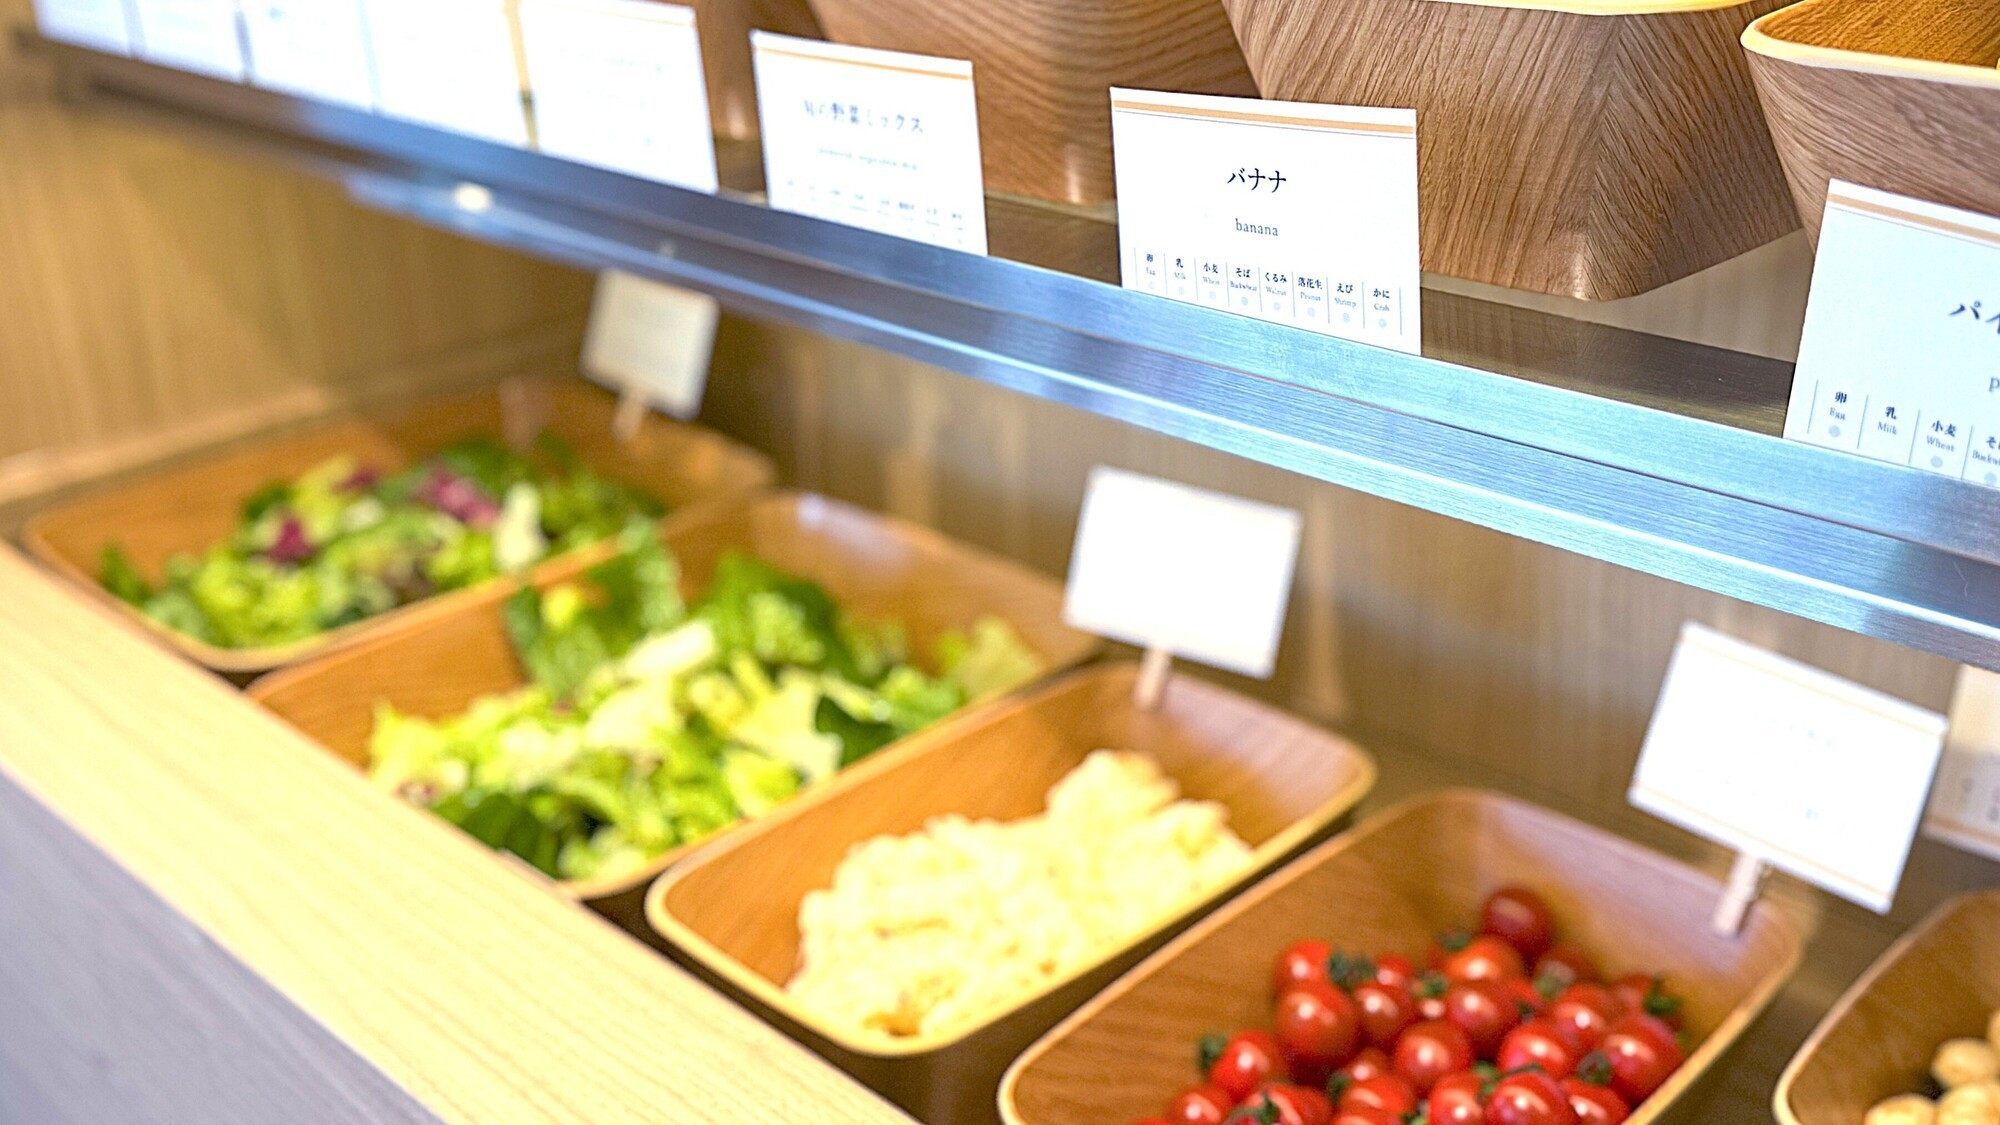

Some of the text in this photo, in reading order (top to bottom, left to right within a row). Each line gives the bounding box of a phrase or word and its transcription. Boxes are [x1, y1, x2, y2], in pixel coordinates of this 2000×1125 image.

[1226, 167, 1287, 193] バナナ
[1234, 218, 1279, 238] banana
[1175, 257, 1184, 269] 乳
[1203, 262, 1219, 275] 小麦
[1235, 267, 1251, 279] そば
[1264, 271, 1288, 284] くるみ
[1297, 276, 1323, 291] 落花生
[1336, 282, 1354, 295] えび
[1372, 287, 1391, 300] かに
[1829, 407, 2000, 466] Egg Milk Wheat Buckw
[1835, 391, 2000, 450] 卵 乳 小麦 そ
